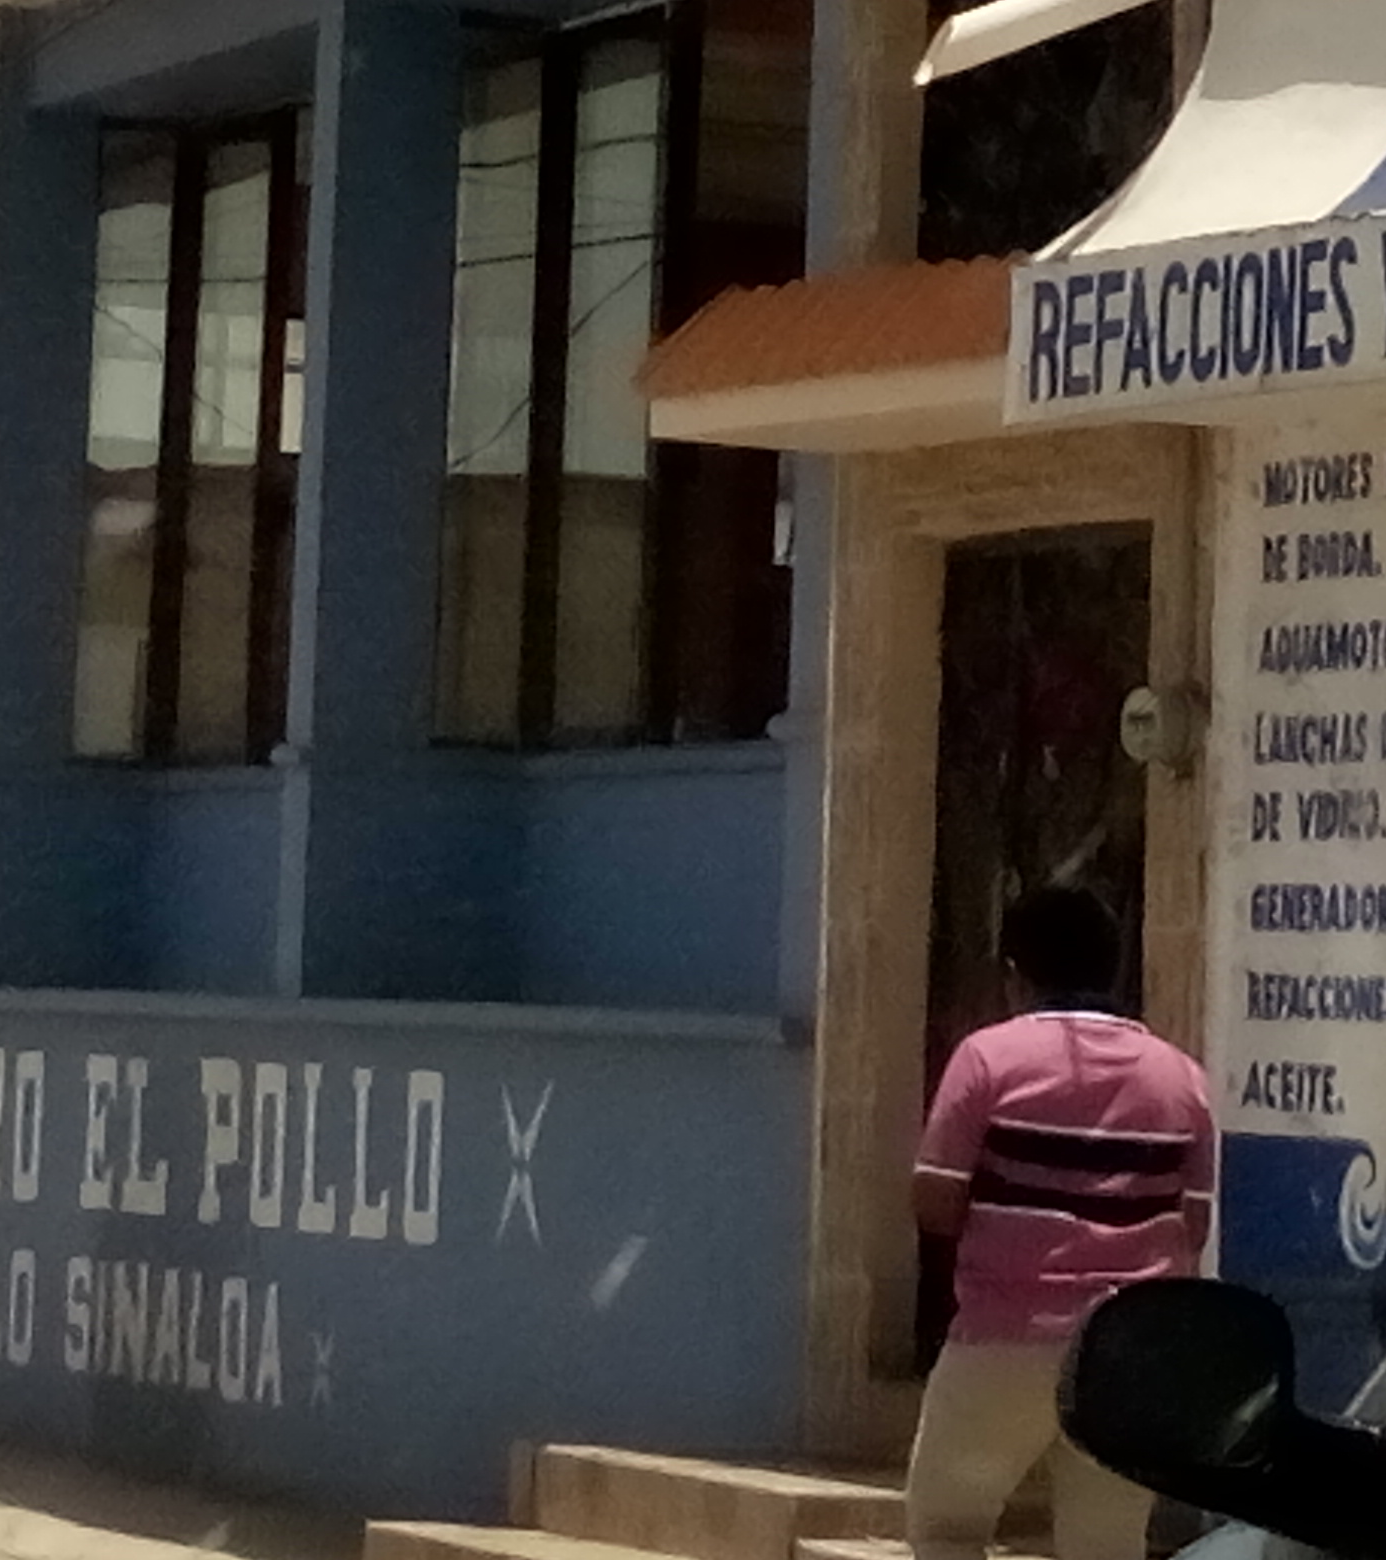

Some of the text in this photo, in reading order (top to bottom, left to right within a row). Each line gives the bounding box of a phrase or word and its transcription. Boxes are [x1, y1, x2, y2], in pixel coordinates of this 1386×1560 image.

[1029, 237, 1357, 403] REFACCIONES
[1263, 452, 1373, 507] MOTORES
[1262, 533, 1288, 582] DE
[1255, 711, 1367, 766] LANCHAS
[1252, 791, 1282, 842] DE
[1241, 1060, 1345, 1114] ACEITE.
[79, 1053, 168, 1216] EL
[198, 1057, 444, 1244] POLLO
[64, 1254, 284, 1408] SINALOA
